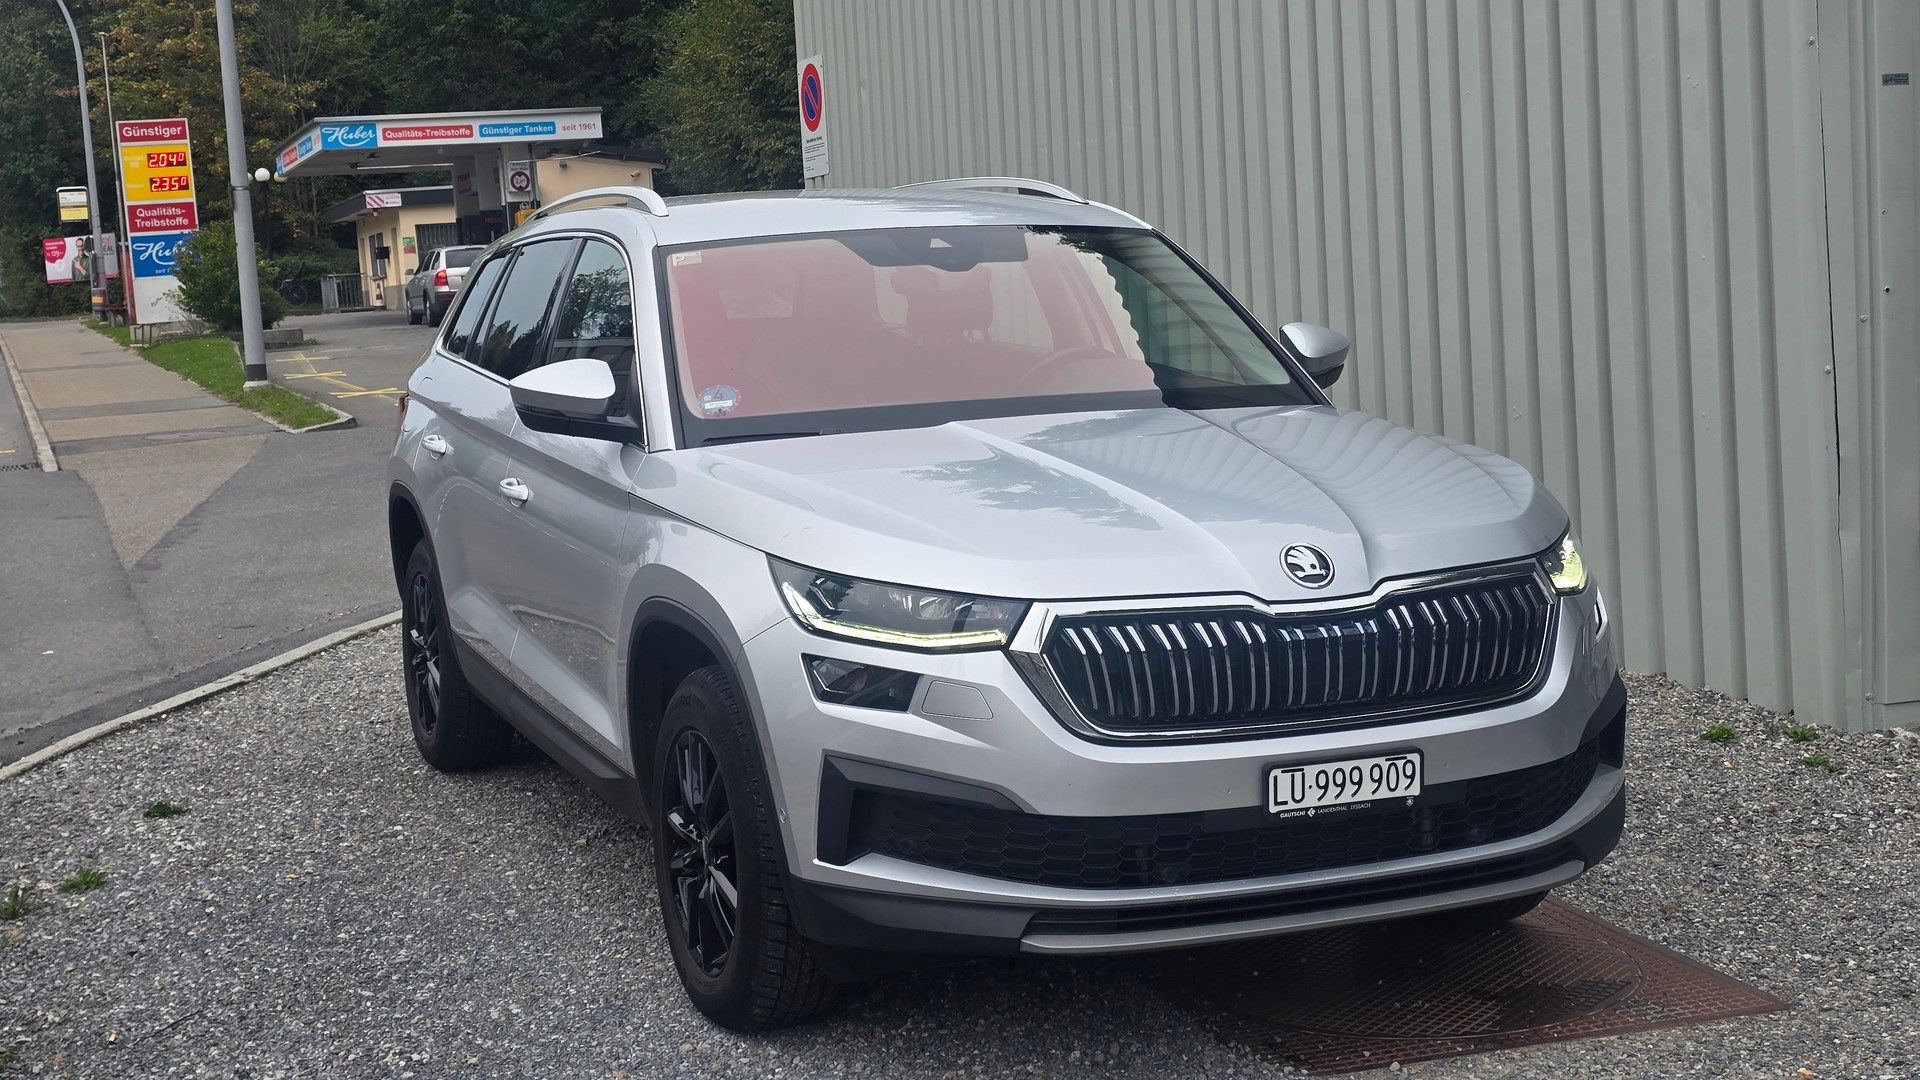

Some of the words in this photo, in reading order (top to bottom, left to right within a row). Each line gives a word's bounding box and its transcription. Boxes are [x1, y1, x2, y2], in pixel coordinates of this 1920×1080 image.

[122, 125, 182, 138] Günstiger
[385, 127, 471, 139] Qualitäts-Treibstoffe
[482, 126, 522, 136] Günstiger
[524, 125, 554, 133] Tanken
[578, 123, 596, 131] 1961
[321, 125, 376, 147] Huber
[136, 206, 186, 217] Qualitäts-
[134, 216, 189, 228] Treibstoffe
[1279, 810, 1306, 819] GAUTSCHI
[1317, 805, 1348, 814] LANGENTHAL
[1350, 802, 1371, 810] LYSSACH
